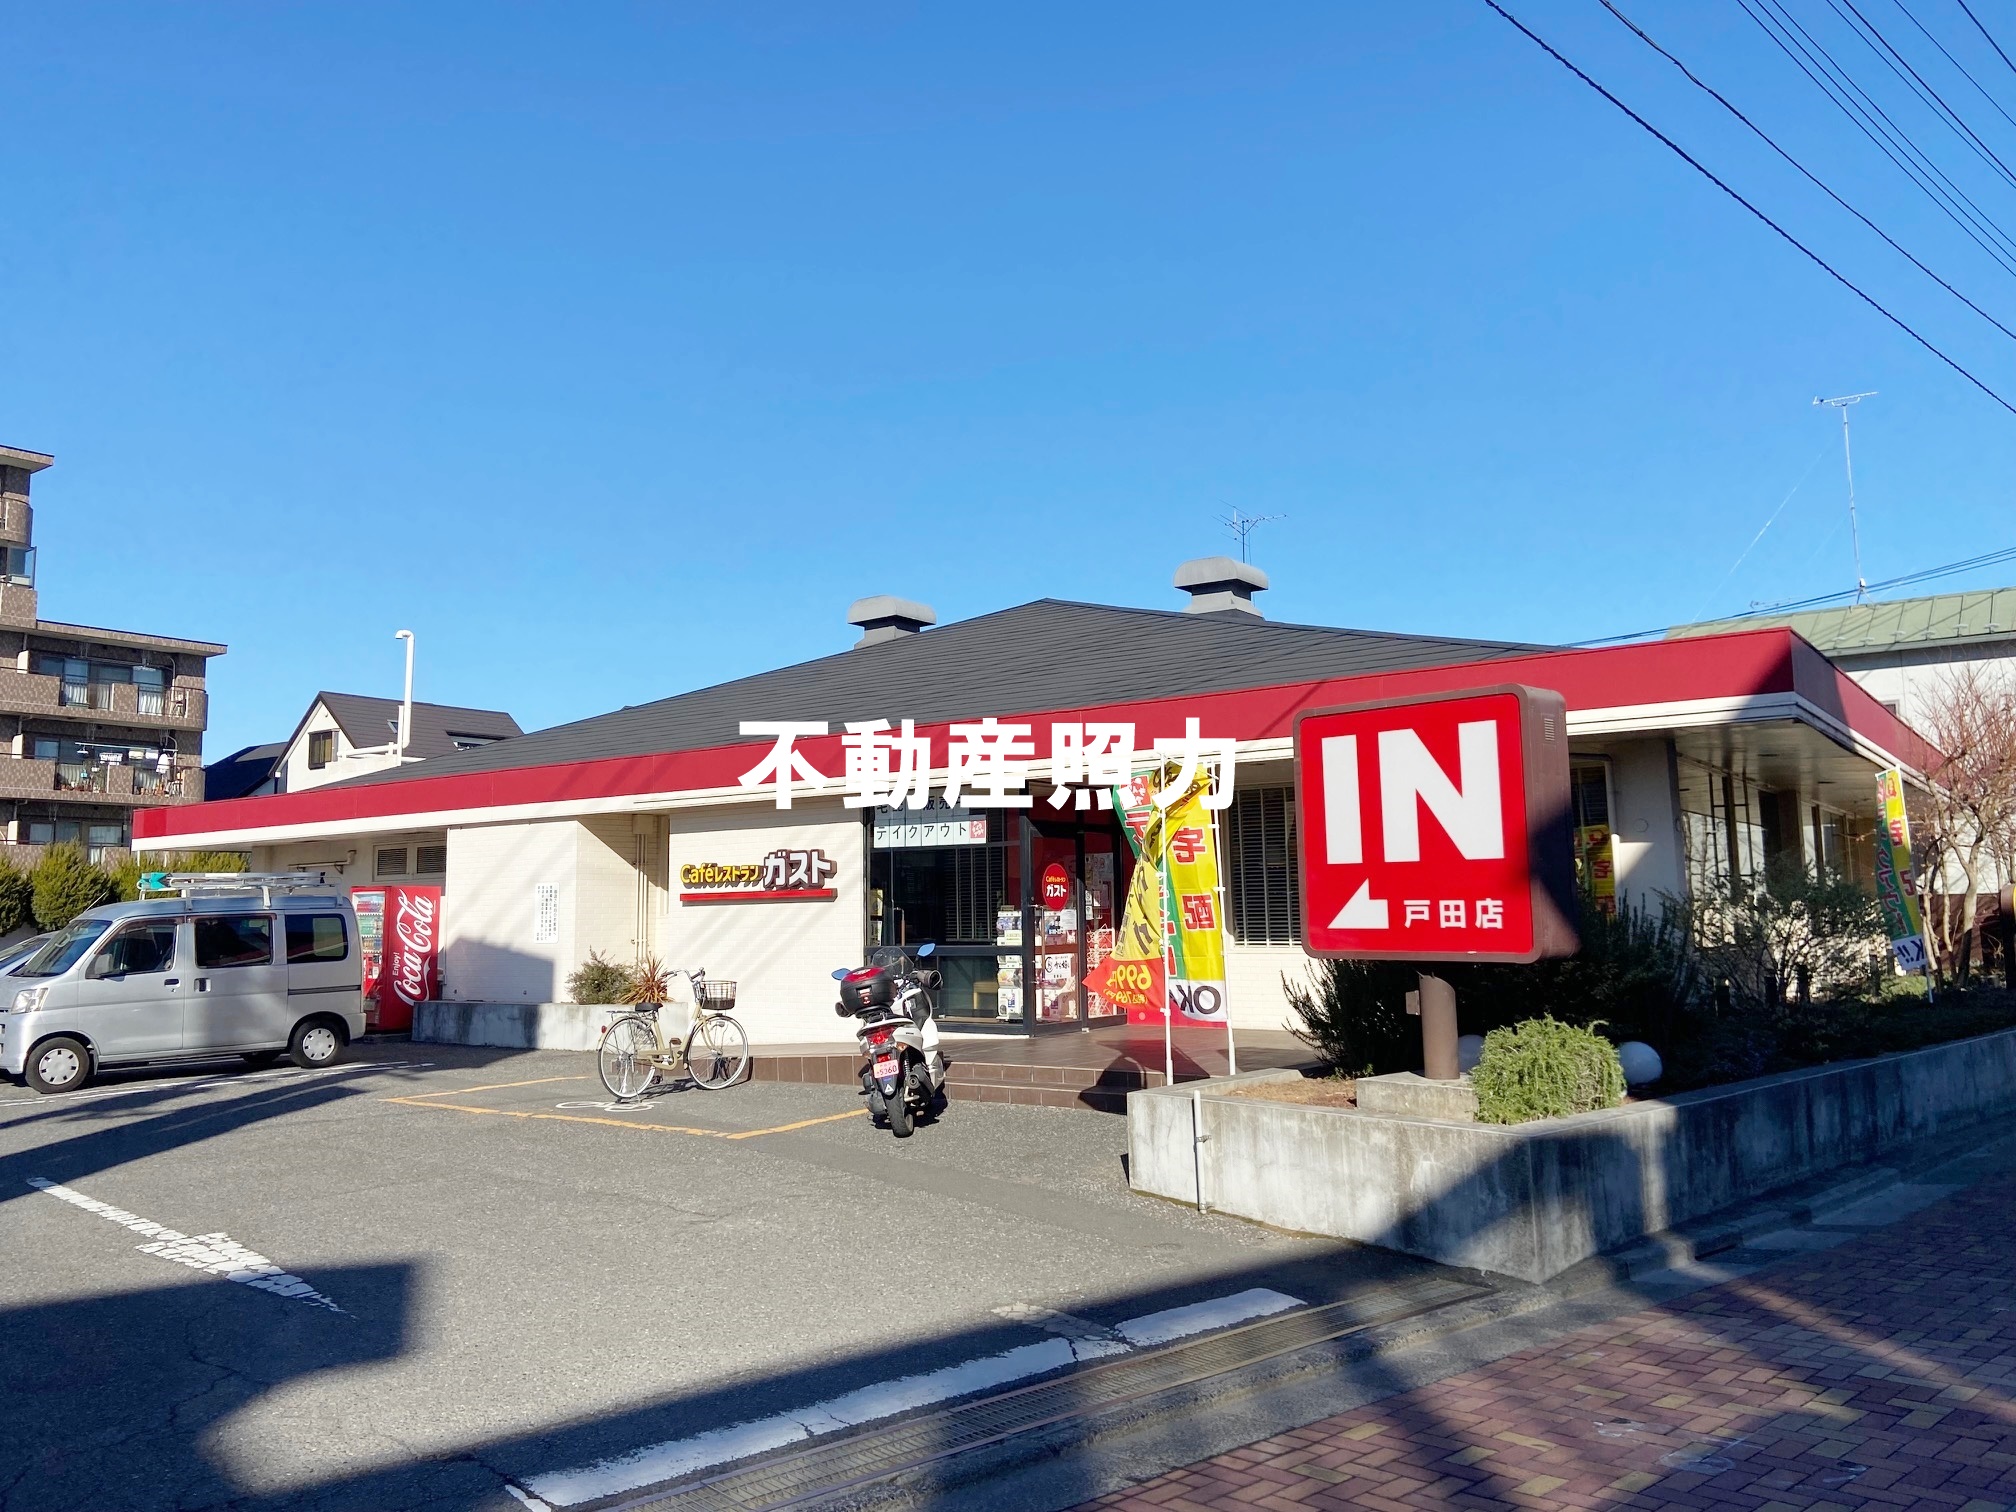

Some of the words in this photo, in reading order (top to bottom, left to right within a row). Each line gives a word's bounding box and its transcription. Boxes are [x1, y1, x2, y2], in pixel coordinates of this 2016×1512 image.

[1321, 720, 1505, 865] IN
[876, 822, 967, 841] テイクアウト
[679, 863, 760, 886] Caféレストラン
[764, 850, 832, 887] ガスト
[1045, 883, 1067, 898] ガスト
[1403, 898, 1505, 930] 戸田店
[392, 951, 401, 976] Enjoy!
[393, 888, 434, 1007] Coca-Cola
